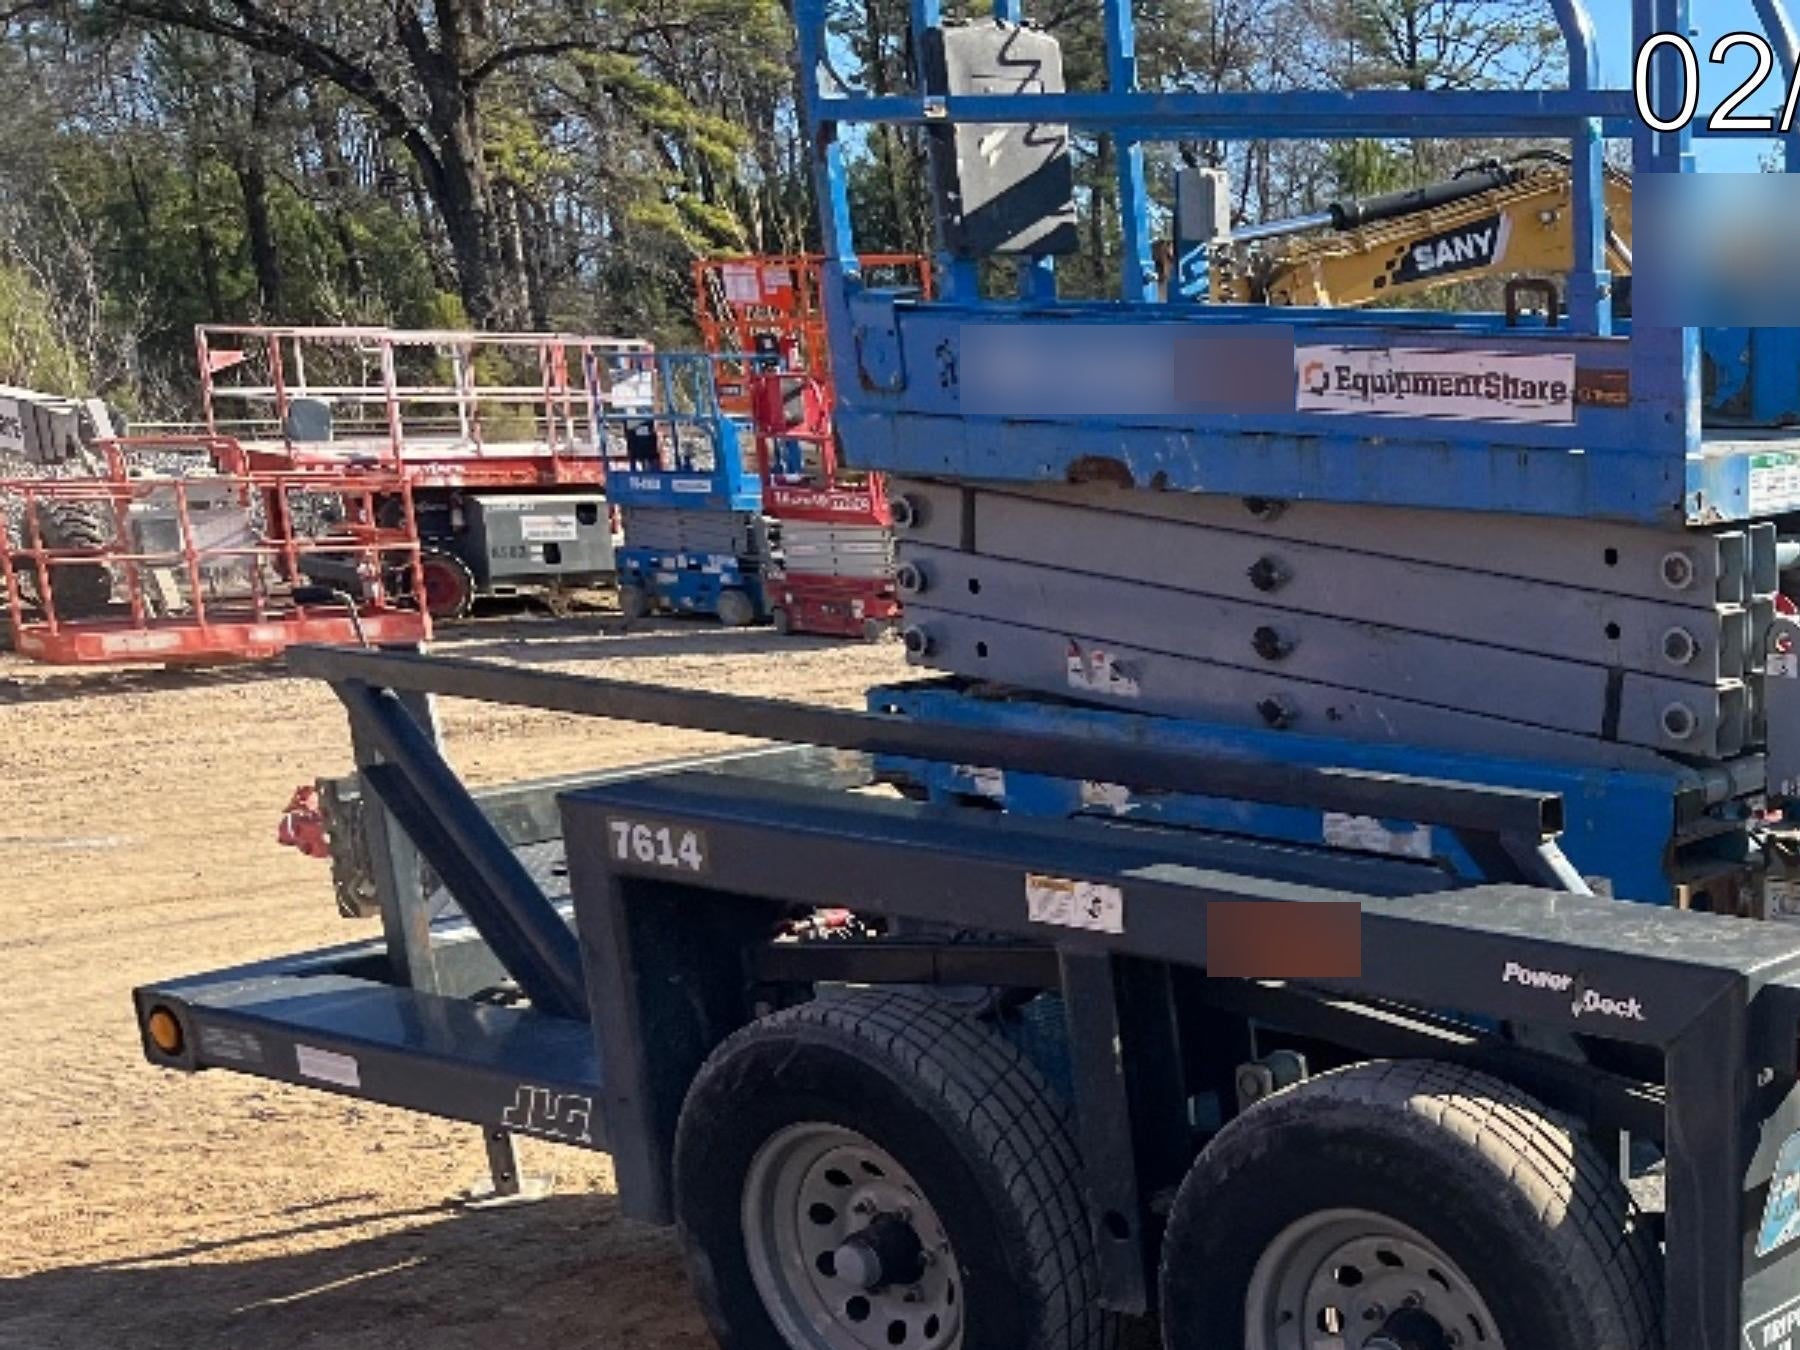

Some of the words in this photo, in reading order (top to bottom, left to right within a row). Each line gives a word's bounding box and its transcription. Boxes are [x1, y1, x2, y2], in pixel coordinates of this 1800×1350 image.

[1413, 226, 1491, 271] SANY
[1334, 365, 1569, 404] EquipmentShare
[610, 821, 703, 871] 7614
[1502, 961, 1573, 991] Power
[1582, 988, 1646, 1021] Deck
[500, 1085, 592, 1143] JLG
